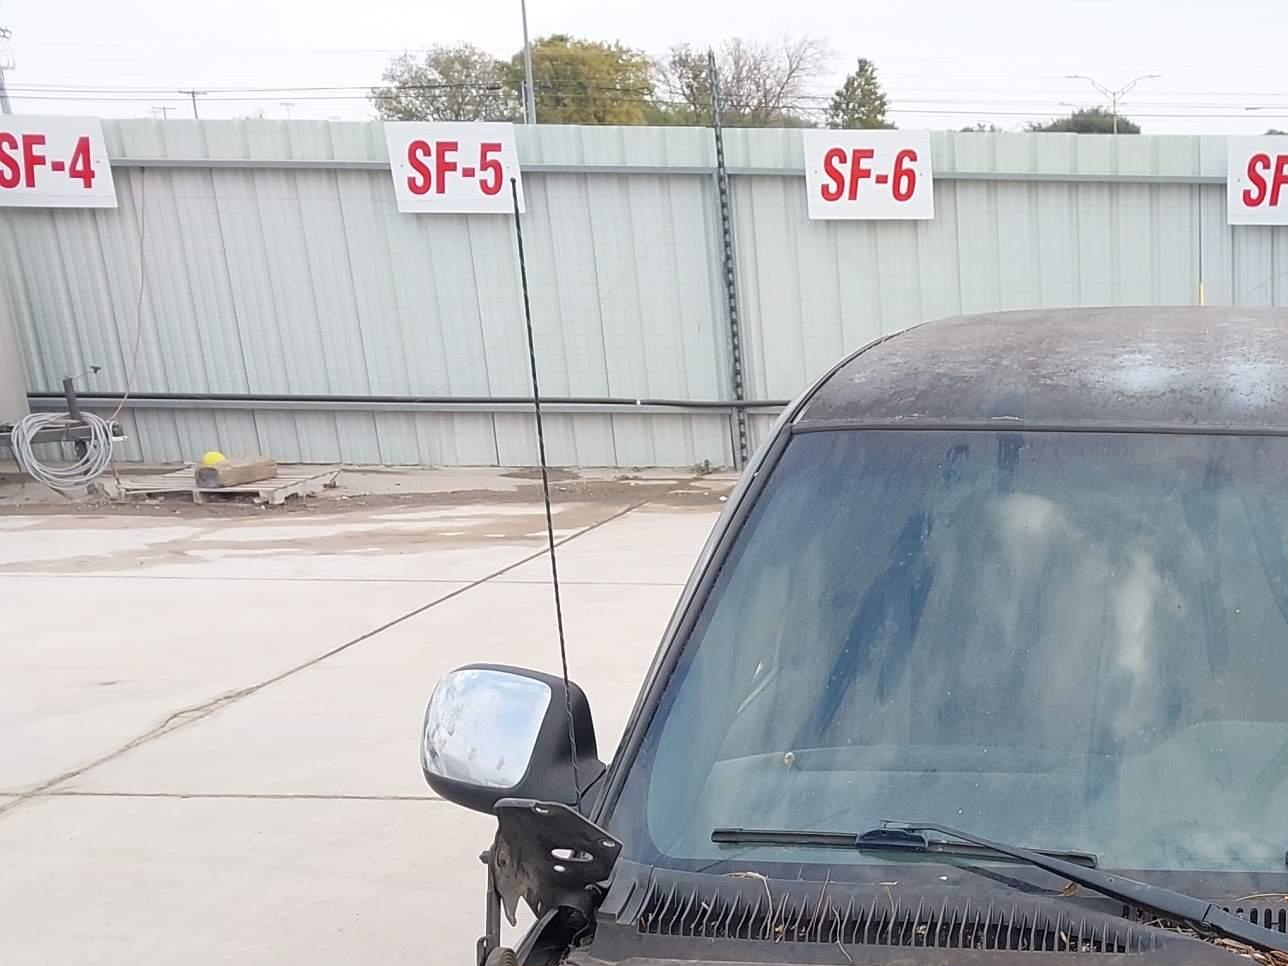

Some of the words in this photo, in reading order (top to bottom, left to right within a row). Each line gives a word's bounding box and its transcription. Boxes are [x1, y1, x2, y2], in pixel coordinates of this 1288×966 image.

[0, 131, 96, 189] SF-4
[406, 138, 503, 196] SF-5
[819, 146, 918, 202] SF-6
